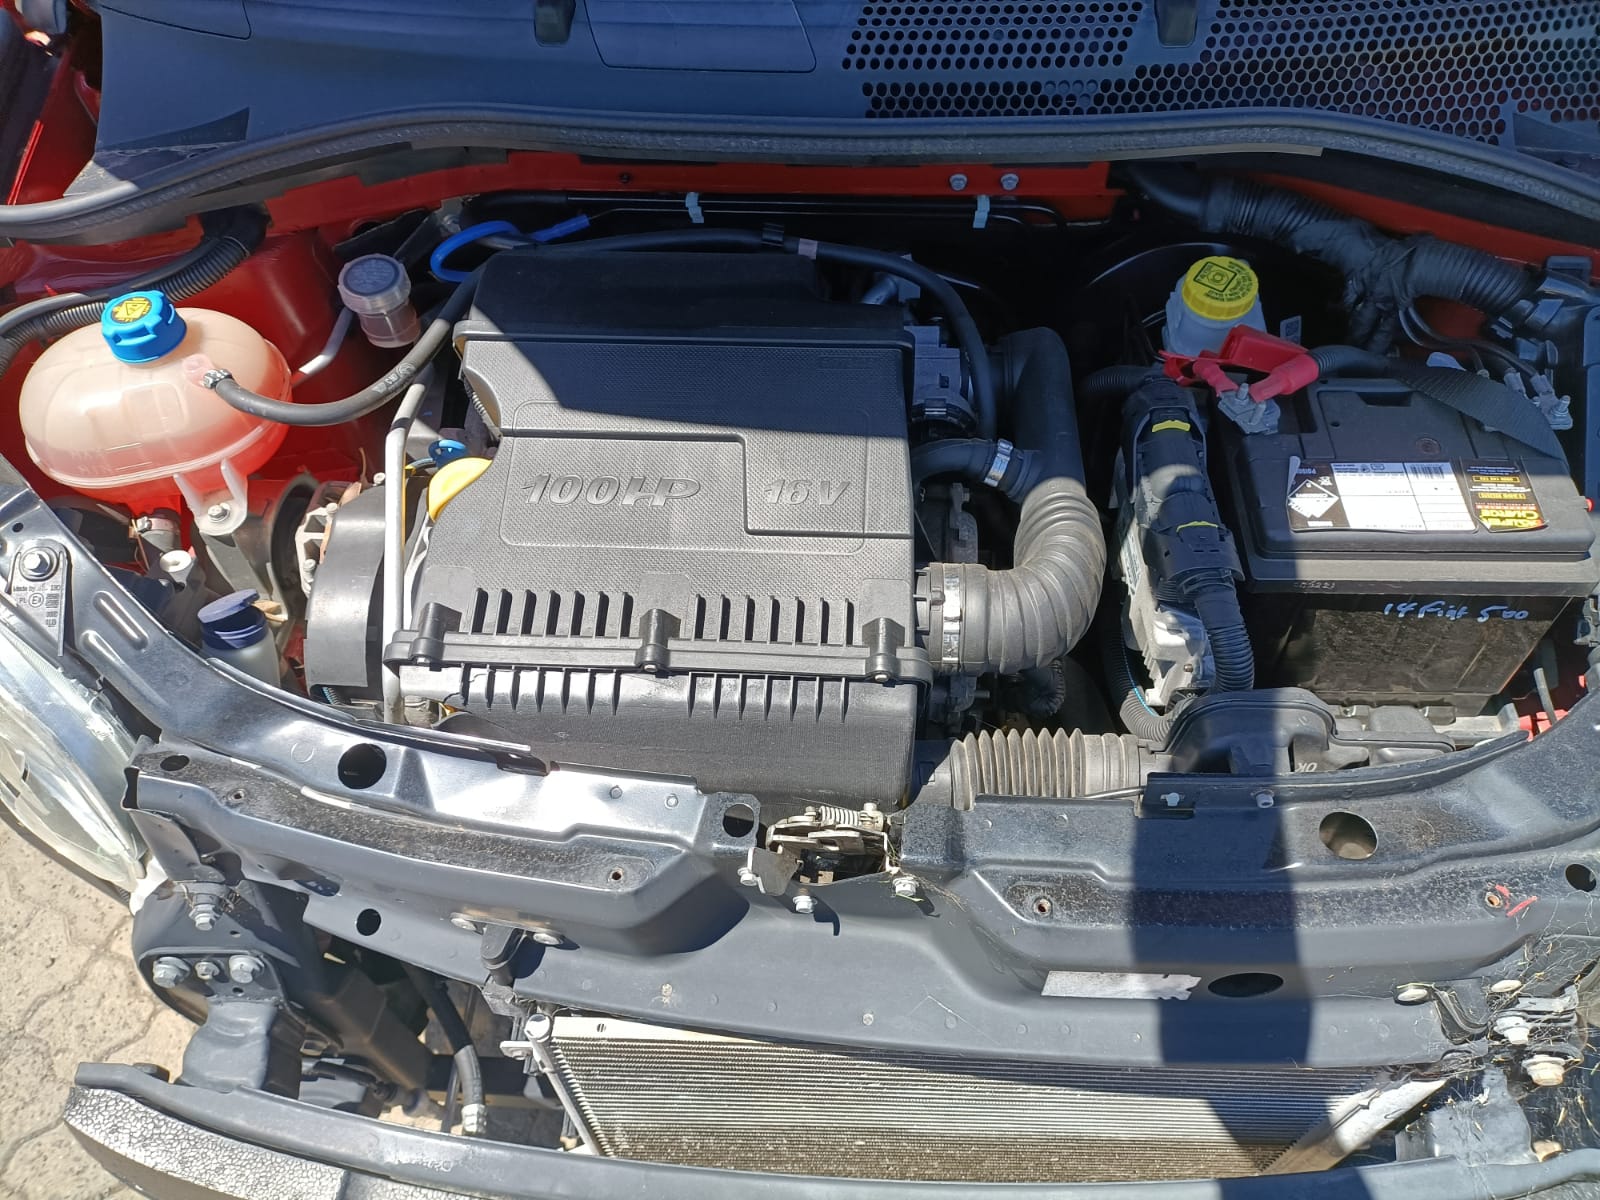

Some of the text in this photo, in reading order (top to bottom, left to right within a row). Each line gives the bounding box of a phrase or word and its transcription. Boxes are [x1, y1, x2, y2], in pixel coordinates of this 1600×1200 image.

[520, 472, 701, 507] 100HP
[763, 478, 850, 506] 16V
[1476, 605, 1529, 623] 500
